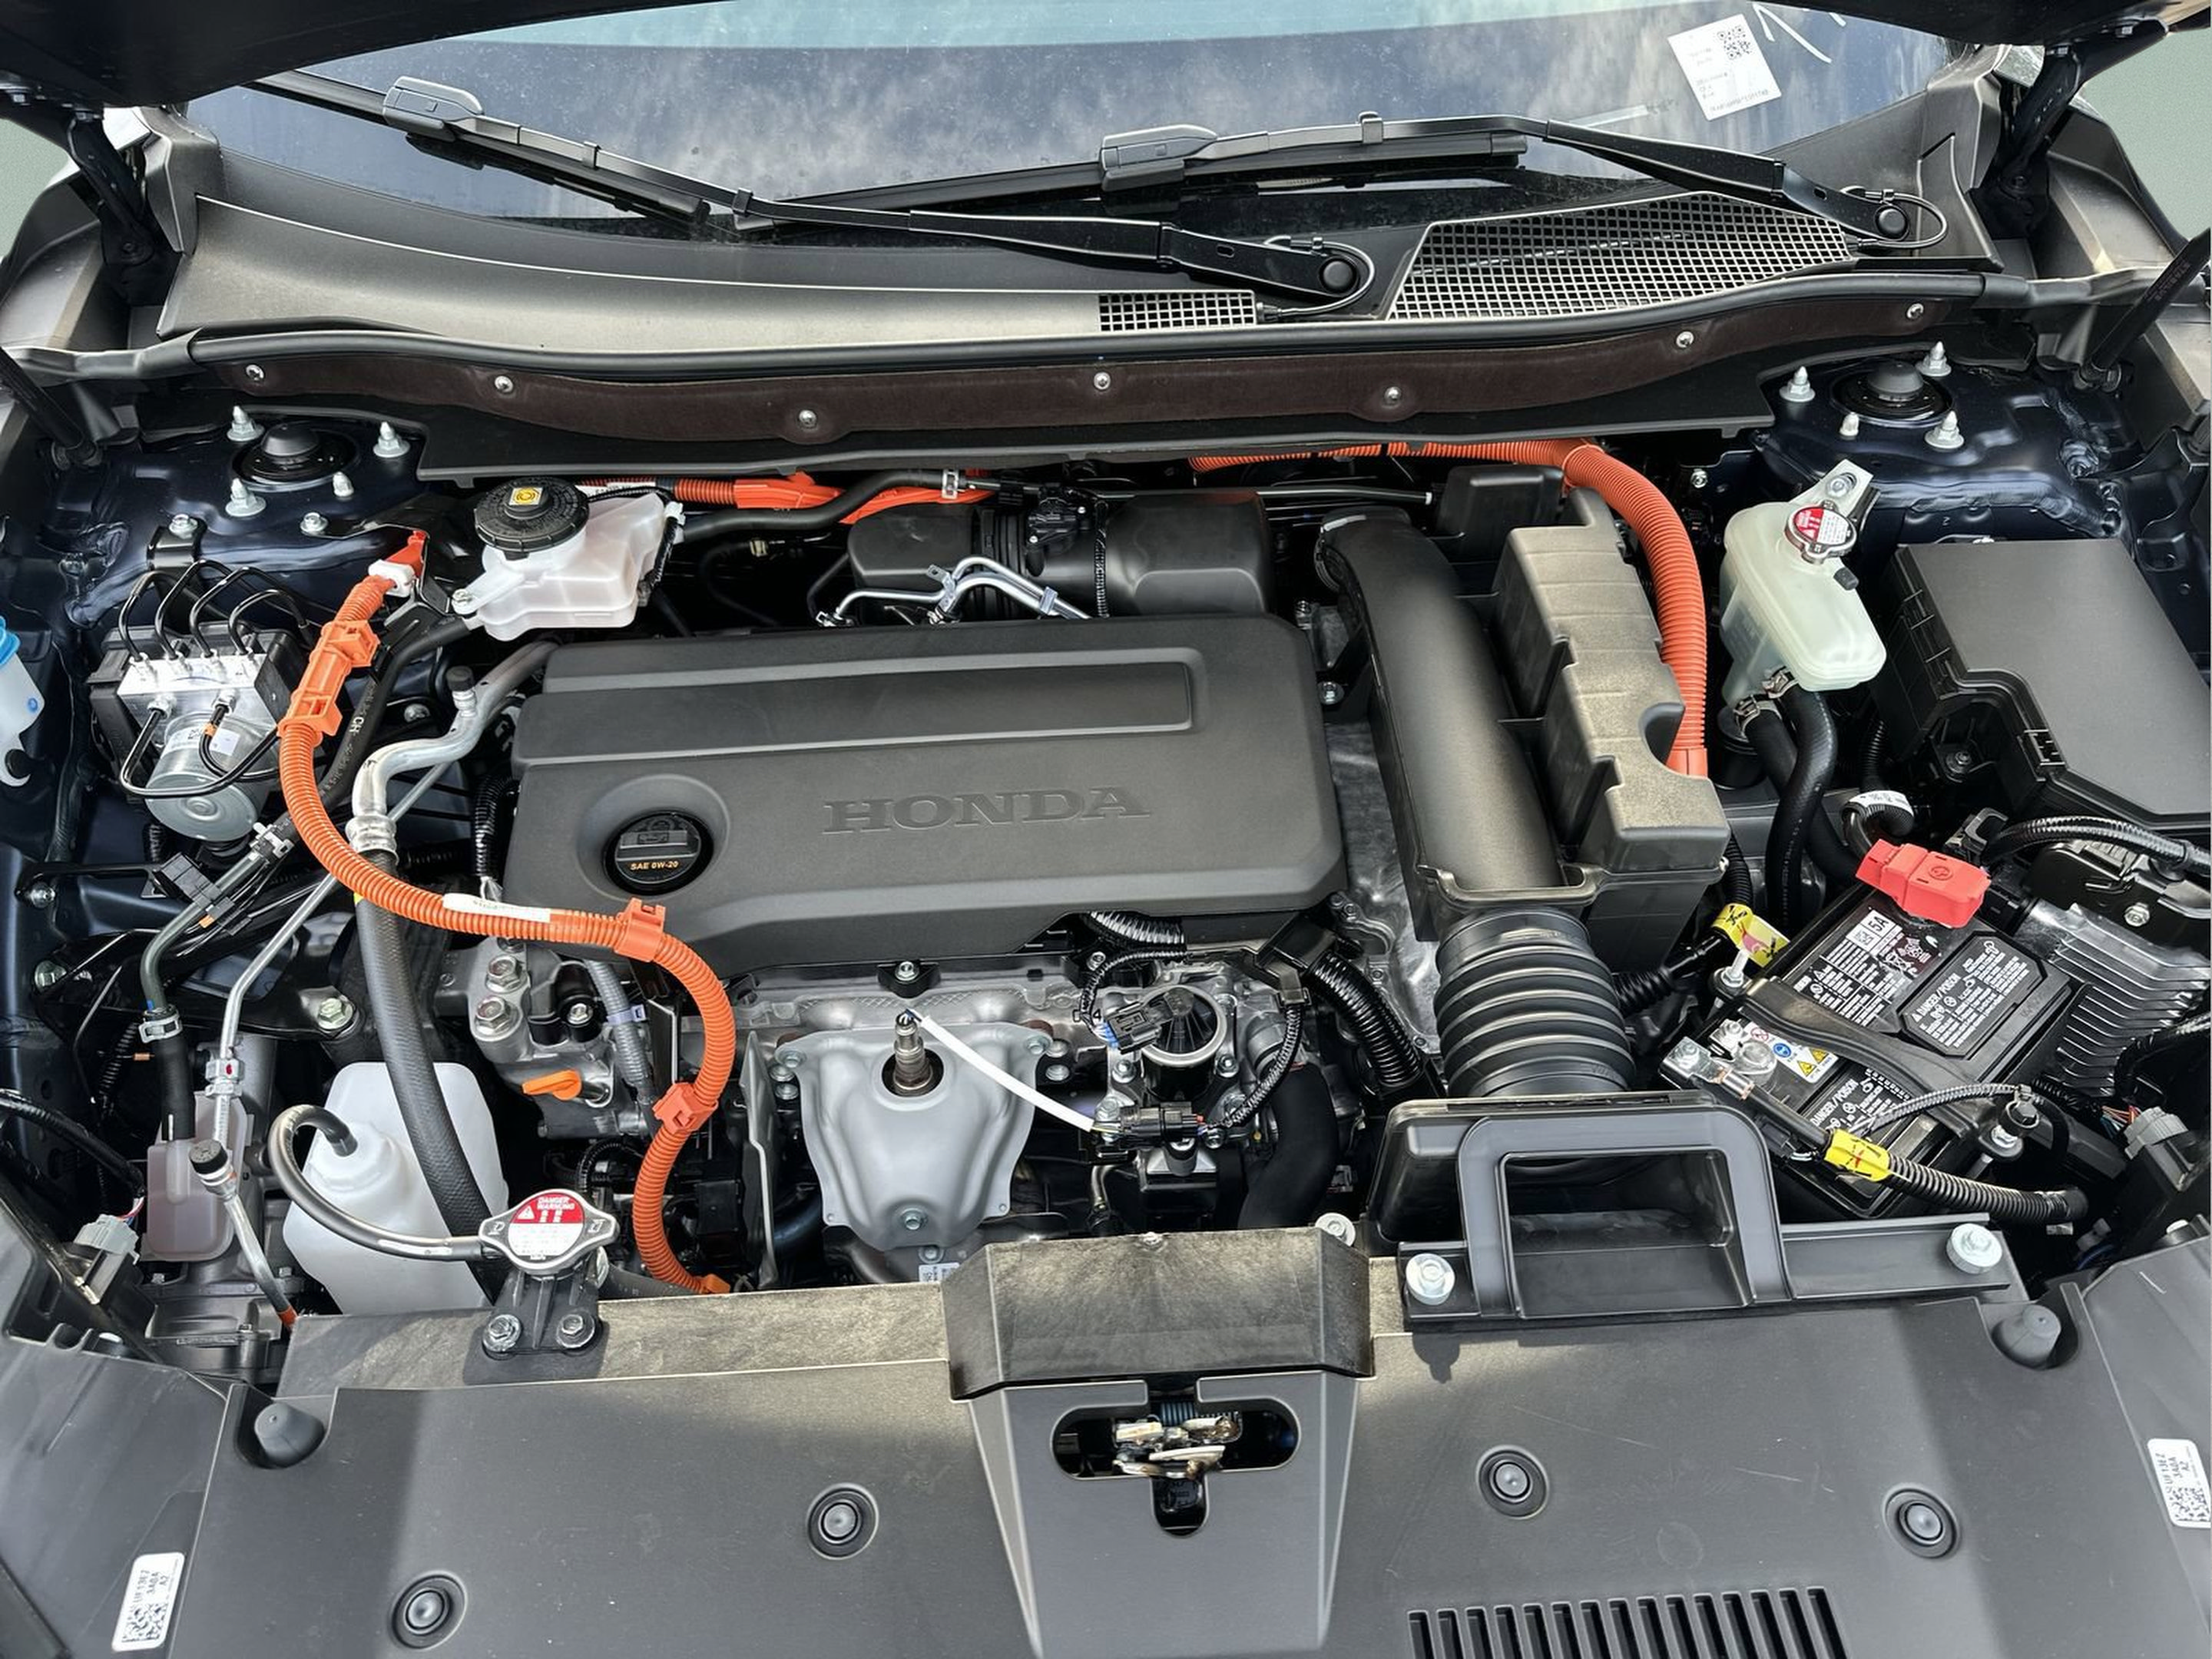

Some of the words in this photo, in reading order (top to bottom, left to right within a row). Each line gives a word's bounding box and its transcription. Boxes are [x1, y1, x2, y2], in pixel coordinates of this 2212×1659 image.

[823, 786, 1152, 835] HONDA
[630, 862, 650, 871] SAE
[651, 860, 680, 869] 0W-20
[1868, 916, 1889, 932] 5A
